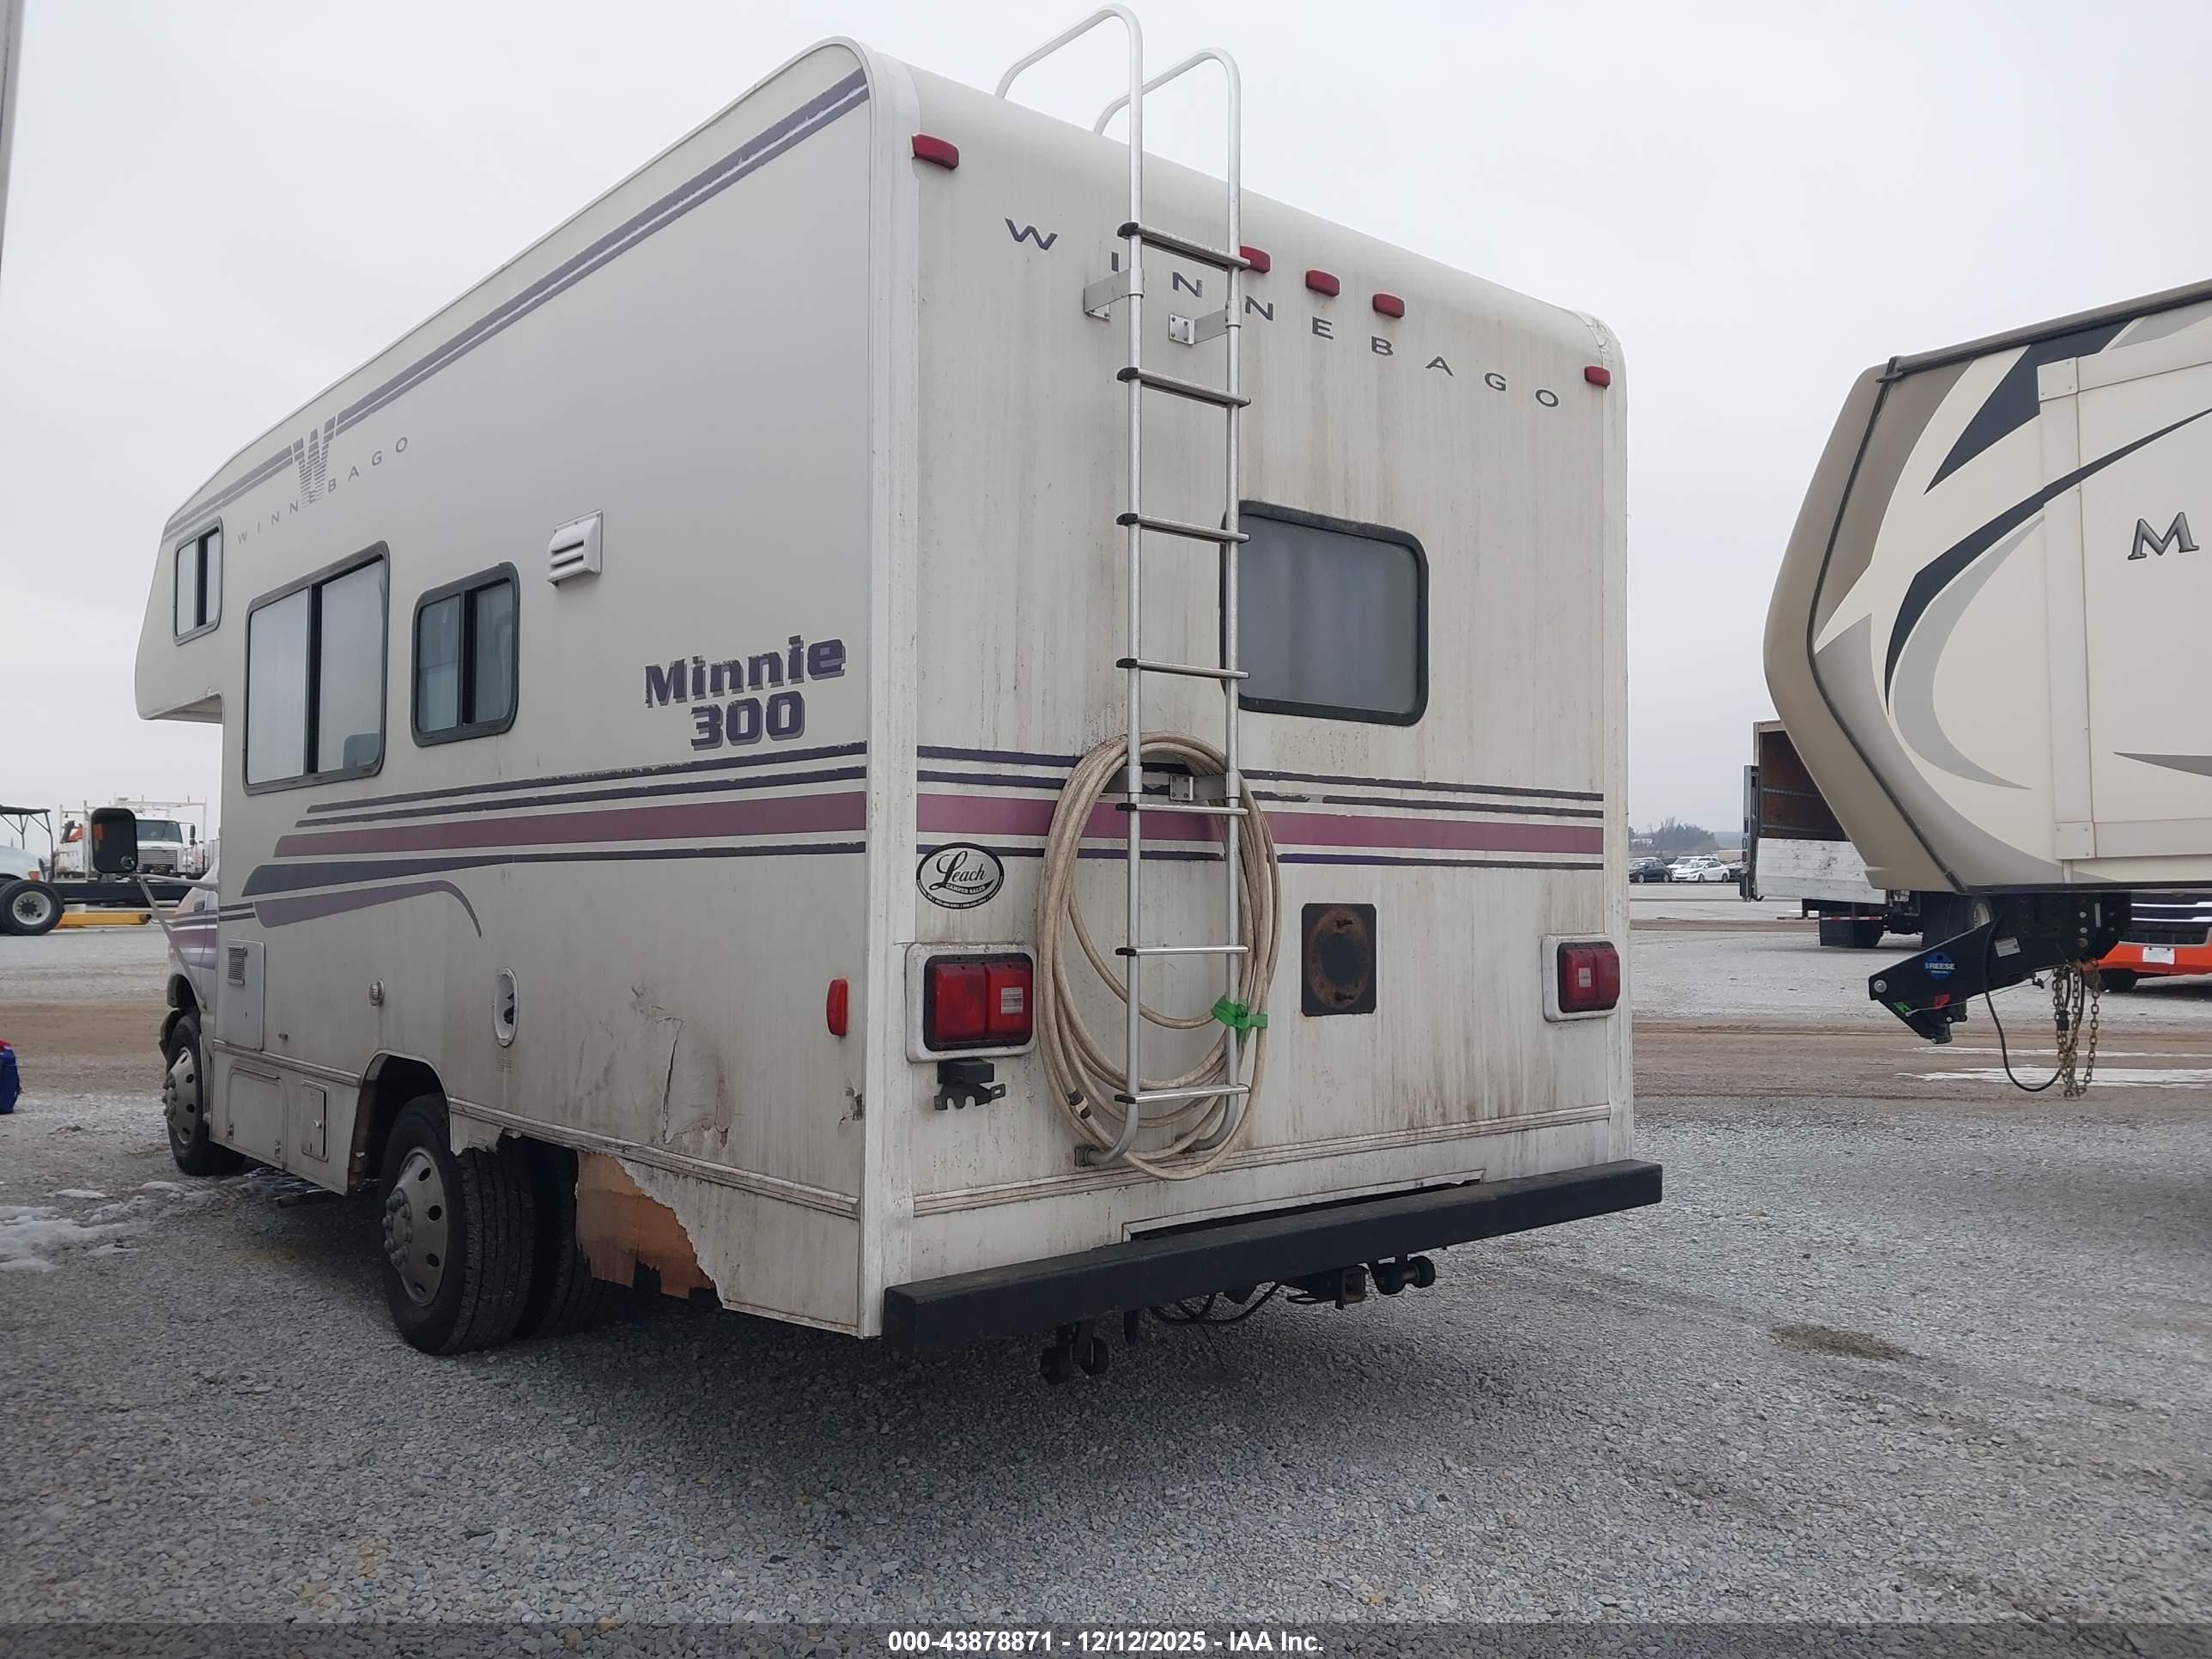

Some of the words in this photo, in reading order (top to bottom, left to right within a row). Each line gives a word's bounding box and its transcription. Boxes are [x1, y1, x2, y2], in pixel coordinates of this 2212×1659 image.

[1004, 217, 1560, 408] WINNEBAGO
[237, 436, 408, 544] WINNEBAGO
[644, 635, 847, 708] Minnie
[690, 690, 805, 751] 300
[929, 850, 987, 890] Leach
